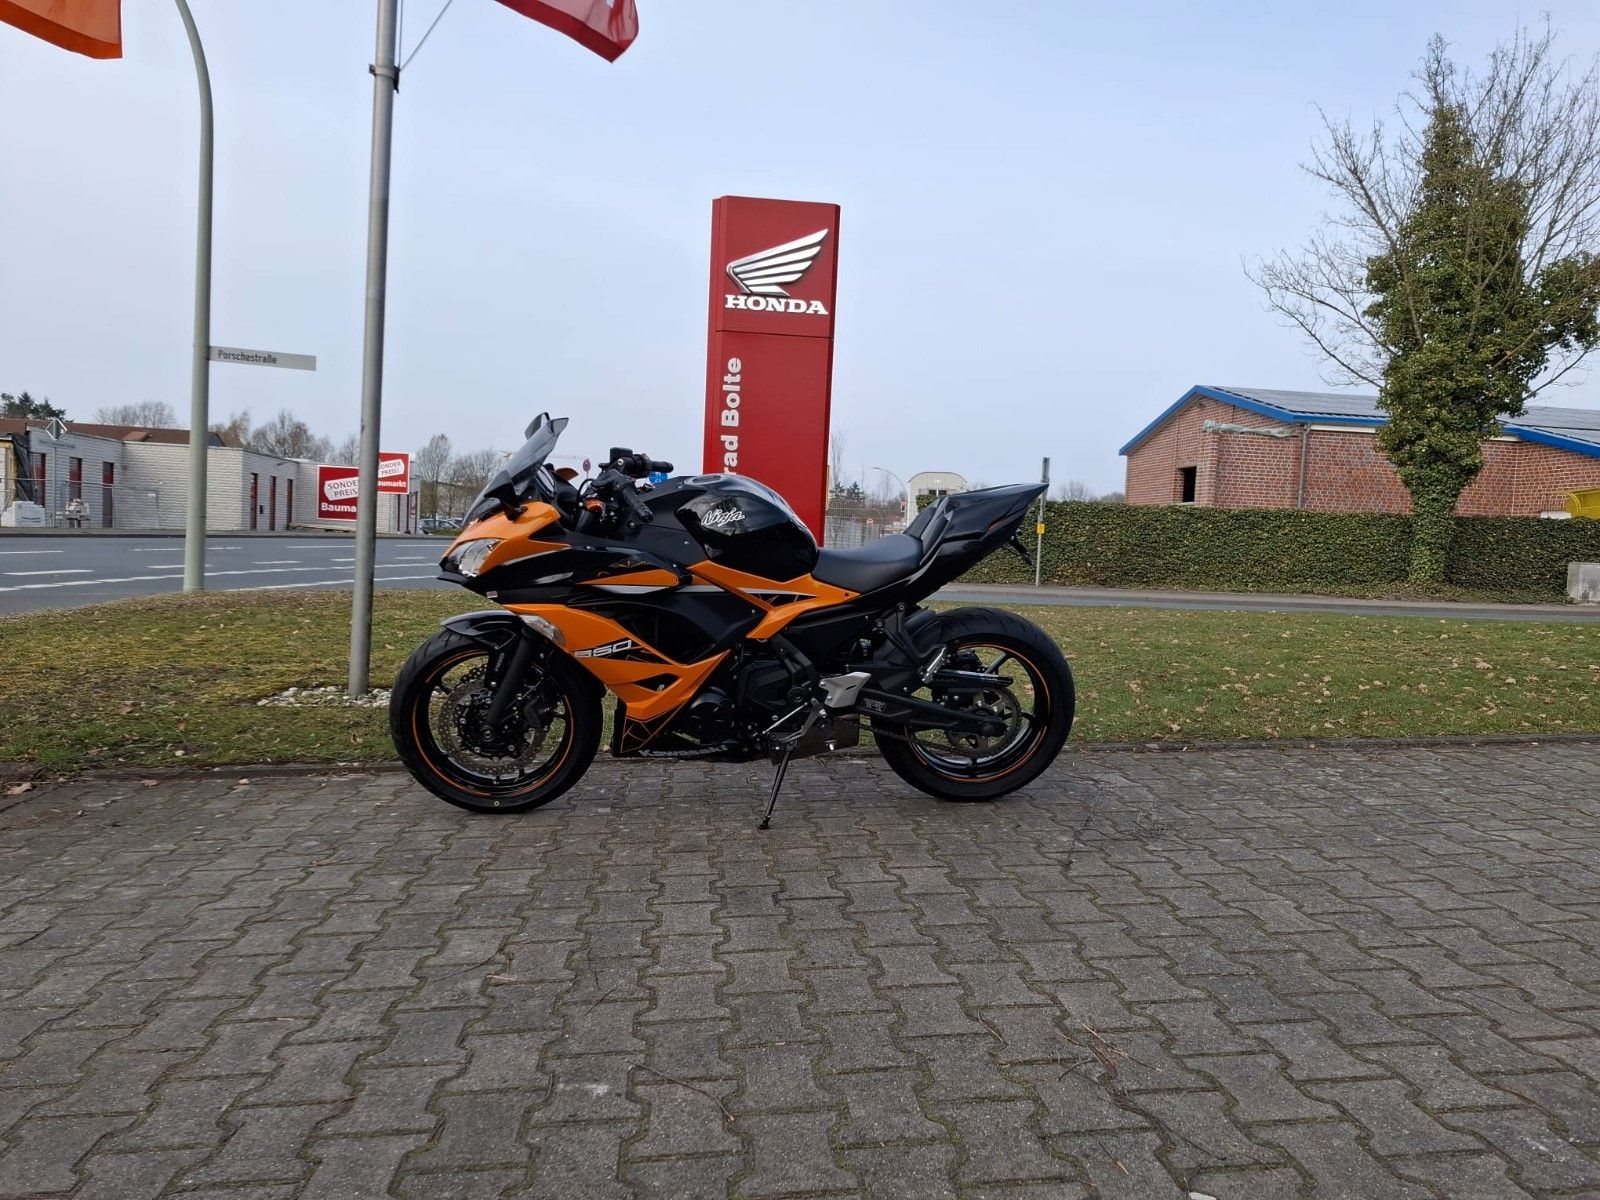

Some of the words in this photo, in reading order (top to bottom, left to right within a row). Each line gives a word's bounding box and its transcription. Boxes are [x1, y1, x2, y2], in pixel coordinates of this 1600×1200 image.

[725, 294, 828, 315] HONDA
[721, 357, 742, 427] Bolte
[327, 479, 358, 490] SONDE
[321, 502, 357, 513] Bauma
[700, 507, 746, 527] Ninja
